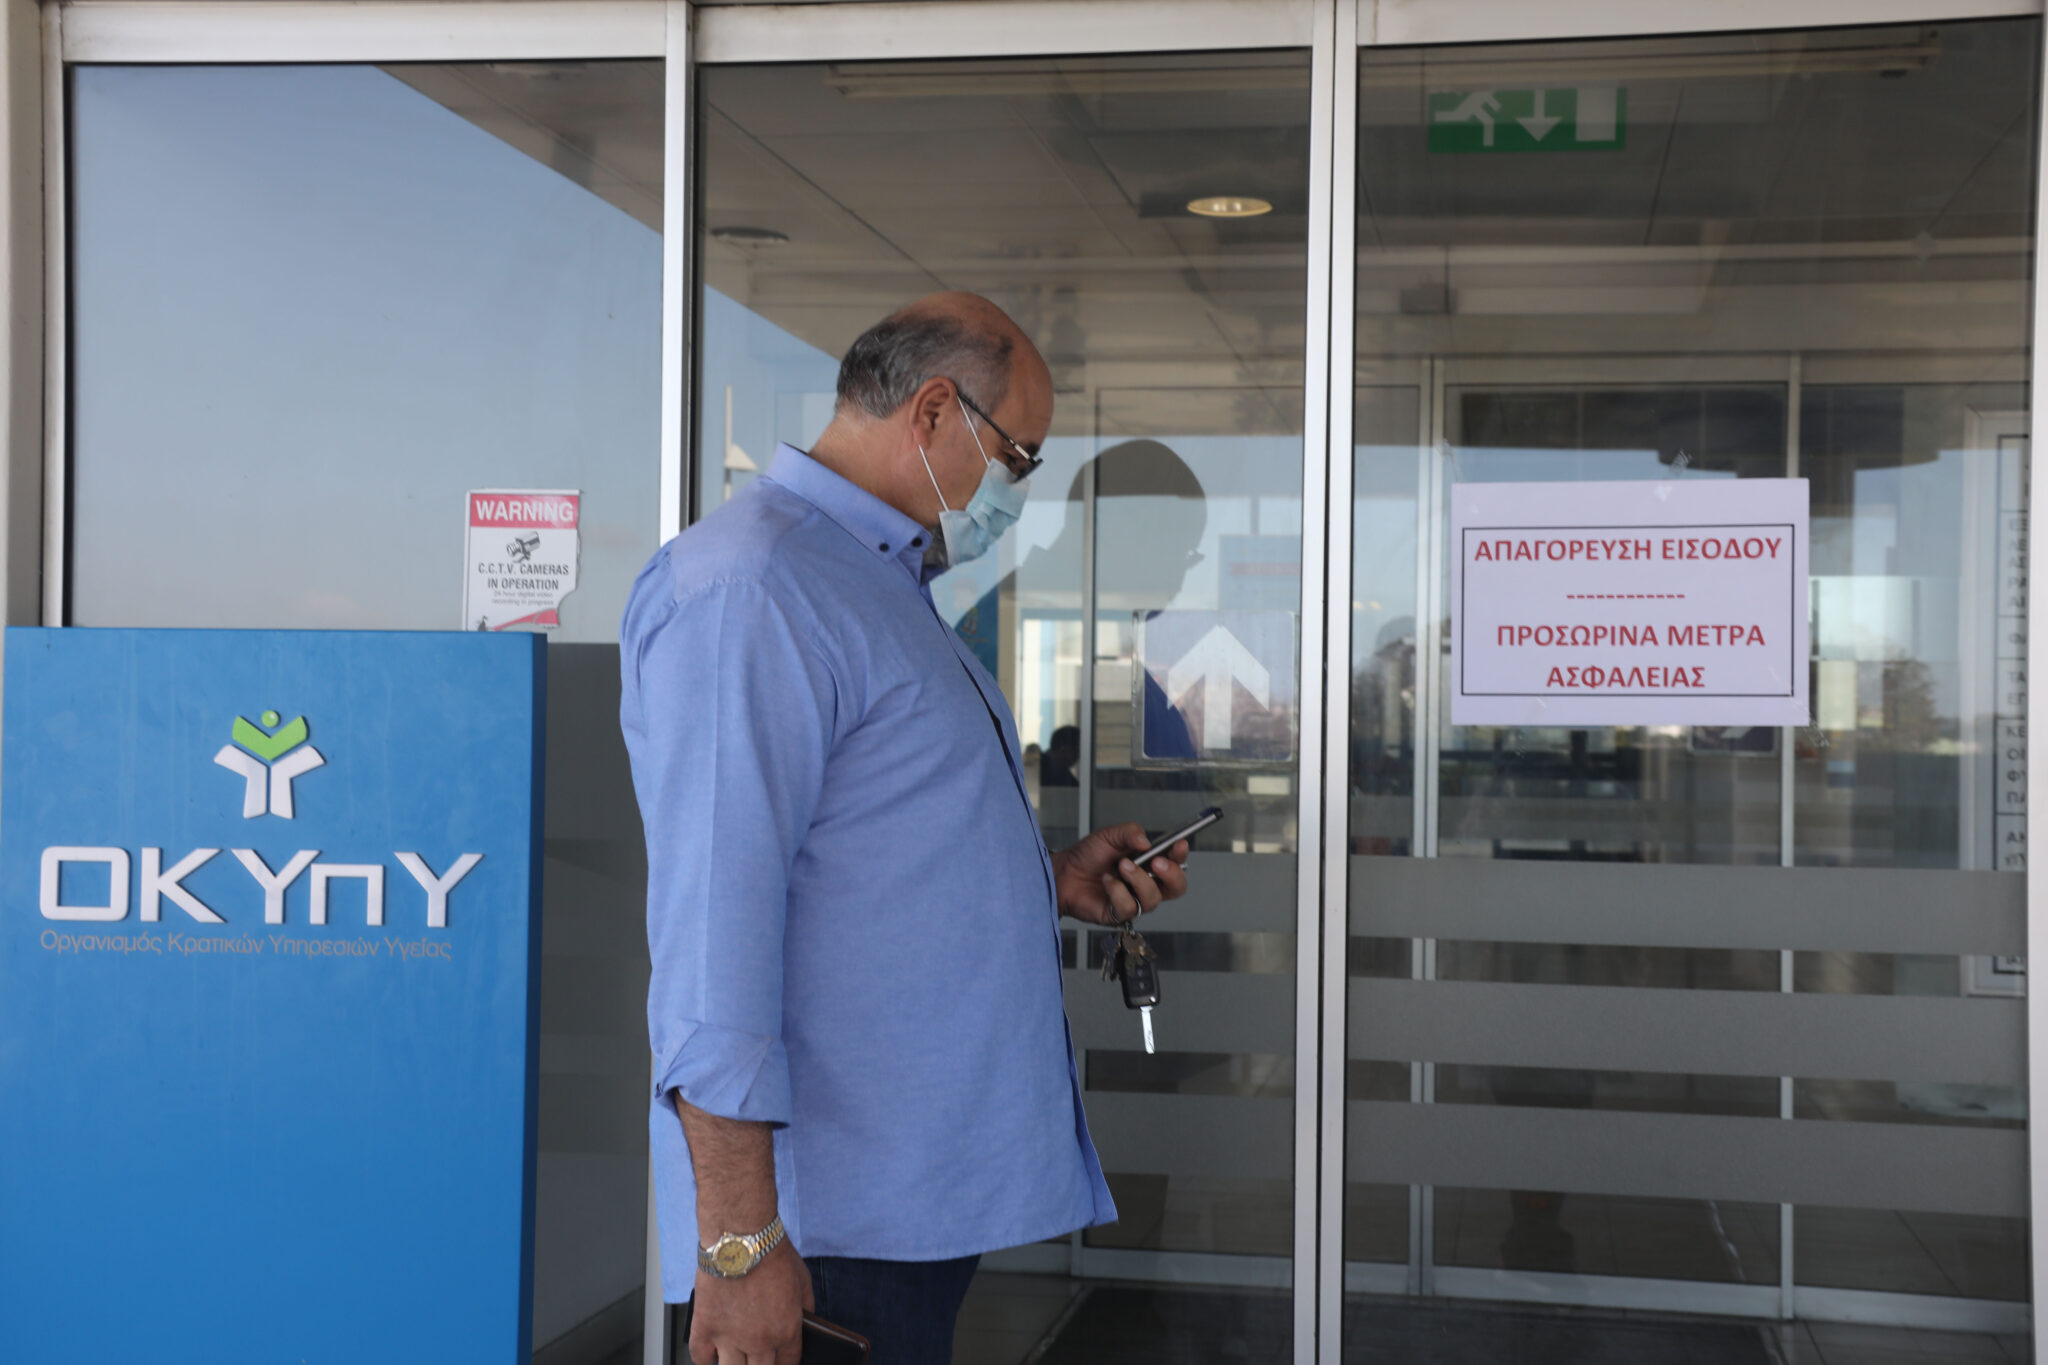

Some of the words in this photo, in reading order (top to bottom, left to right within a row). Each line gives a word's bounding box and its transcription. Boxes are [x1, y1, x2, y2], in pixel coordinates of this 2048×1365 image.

[475, 500, 574, 522] WARNING
[1473, 538, 1652, 561] ΑΠΑΓΟΡΕΥΣΗ
[1661, 537, 1782, 560] ΕΙΣΟΔΟΥ
[478, 562, 517, 575] C.C.T.V.
[519, 563, 570, 576] CAMERAS
[487, 577, 499, 589] IN
[501, 577, 560, 591] OPERATION
[1497, 625, 1660, 647] ΠΡΟΣΩΡΙΝΑ
[1667, 624, 1766, 647] ΜΕΤΡΑ
[1546, 664, 1706, 690] ΑΣΦΑΛΕΙΑΣ
[40, 846, 485, 927] ΟΚΥΠΥ
[40, 929, 163, 956] Οργανισμός
[167, 931, 265, 957] Κρατικών
[268, 933, 380, 960] Υπηρεσιών
[382, 936, 453, 961] Υγείας
